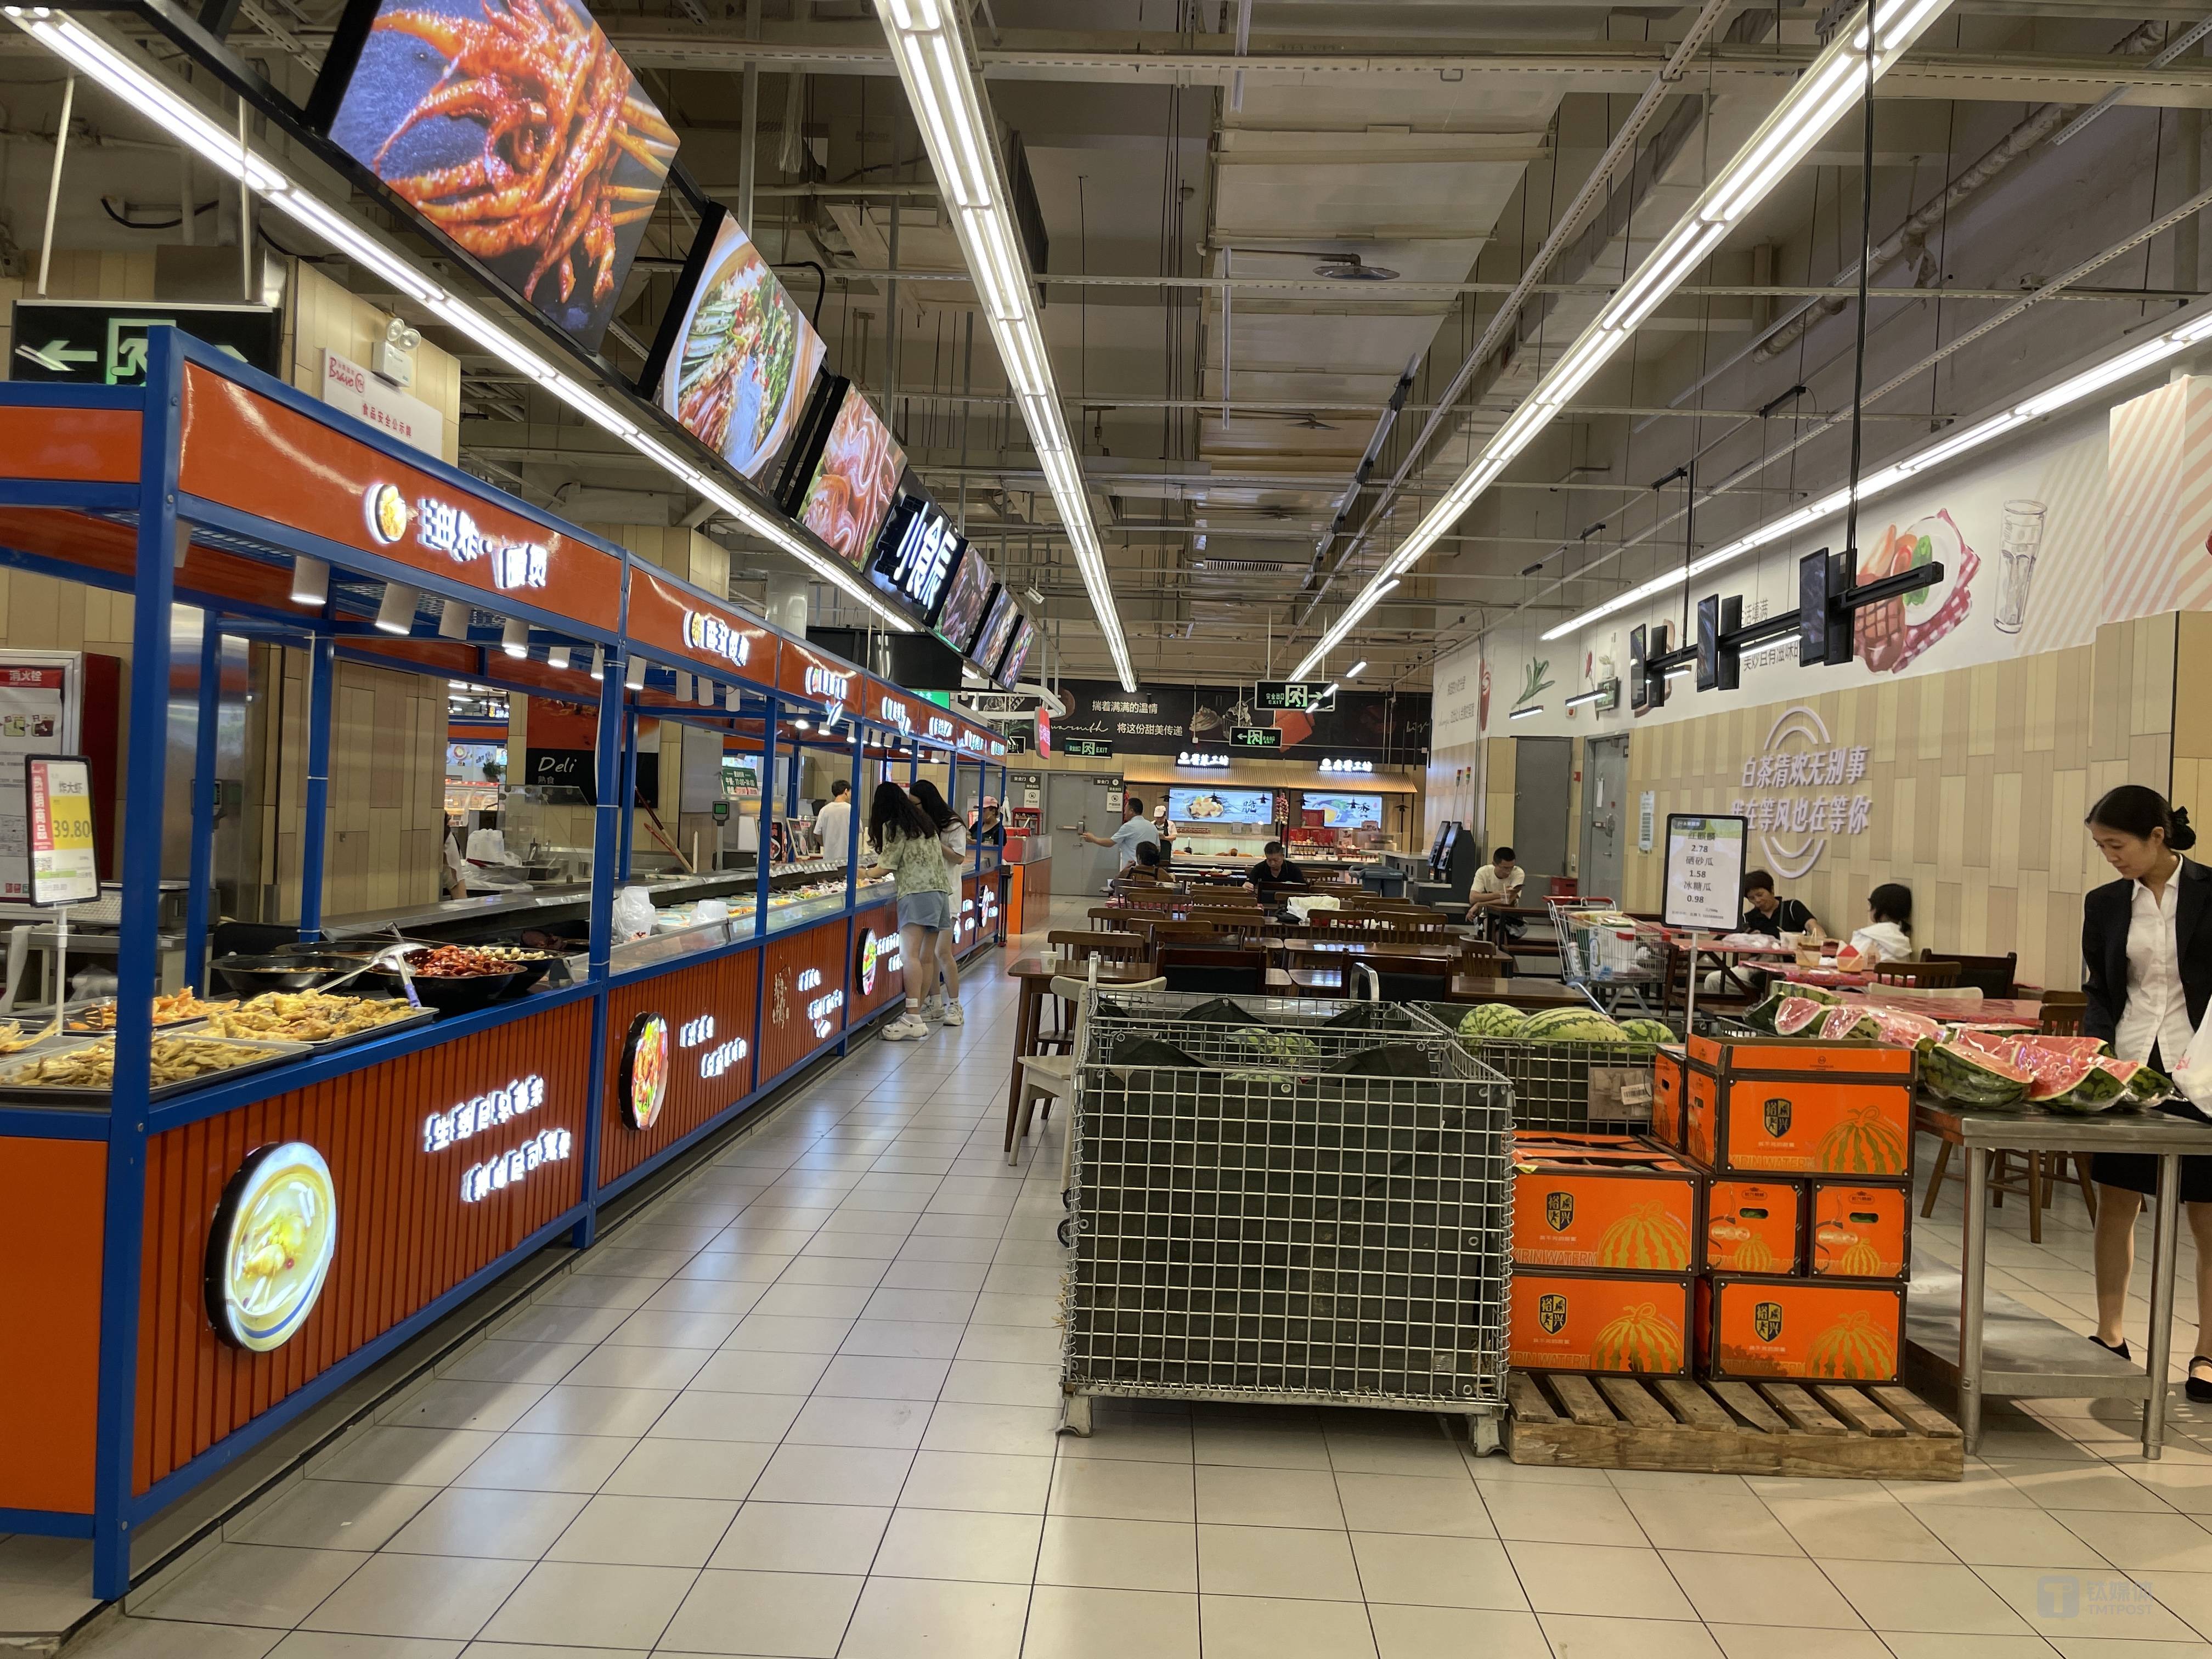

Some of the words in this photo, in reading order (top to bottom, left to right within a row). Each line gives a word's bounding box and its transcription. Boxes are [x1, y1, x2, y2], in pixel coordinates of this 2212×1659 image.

[329, 357, 354, 387] Bravo
[363, 403, 412, 438] 食品安全公示牌
[1741, 597, 1768, 626] 活填满
[9, 670, 42, 682] 消火栓
[1092, 700, 1158, 714] 揣着满满的温情
[1117, 722, 1183, 737] 将这份甜美传递
[538, 757, 577, 772] Deli
[1741, 745, 1872, 788] 白茶清欢无别事
[59, 781, 83, 794] 炸大虾
[53, 820, 91, 838] 39.80
[1691, 844, 1708, 853] 2.78
[1686, 856, 1714, 866] 硒砂瓜
[1689, 870, 1706, 878] 1.58
[1684, 881, 1712, 891] 冰糖瓜
[1686, 895, 1704, 903] 0.98
